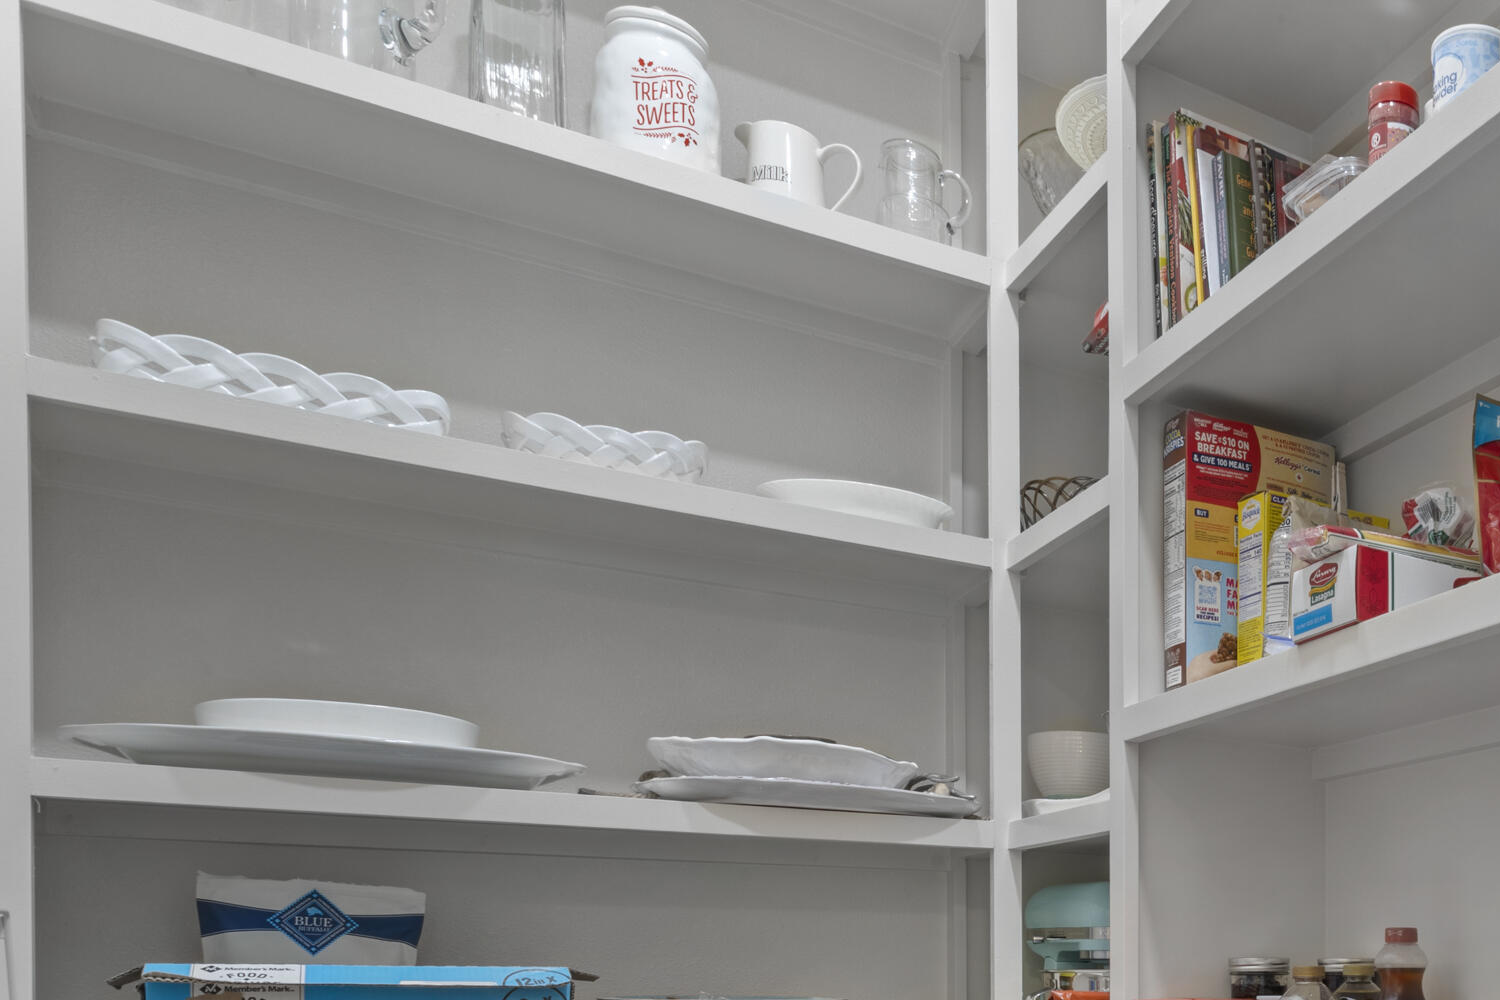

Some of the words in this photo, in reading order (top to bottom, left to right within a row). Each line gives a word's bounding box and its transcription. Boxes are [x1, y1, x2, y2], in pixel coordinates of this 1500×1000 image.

[632, 79, 684, 101] TREATS
[687, 83, 699, 104] &
[636, 102, 696, 127] SWEETS
[752, 164, 790, 183] Milk
[1166, 186, 1175, 237] Complete
[1169, 239, 1177, 279] Venison
[1194, 431, 1218, 444] SAVE
[1222, 436, 1236, 447] $10
[1237, 440, 1250, 451] ON
[1193, 454, 1199, 462] &
[1200, 455, 1216, 465] GIVE
[1217, 458, 1228, 467] 100
[1197, 442, 1248, 461] BREAKFAST
[1311, 589, 1334, 604] Lasagna
[294, 916, 333, 928] BLUE
[223, 985, 268, 993] Member's
